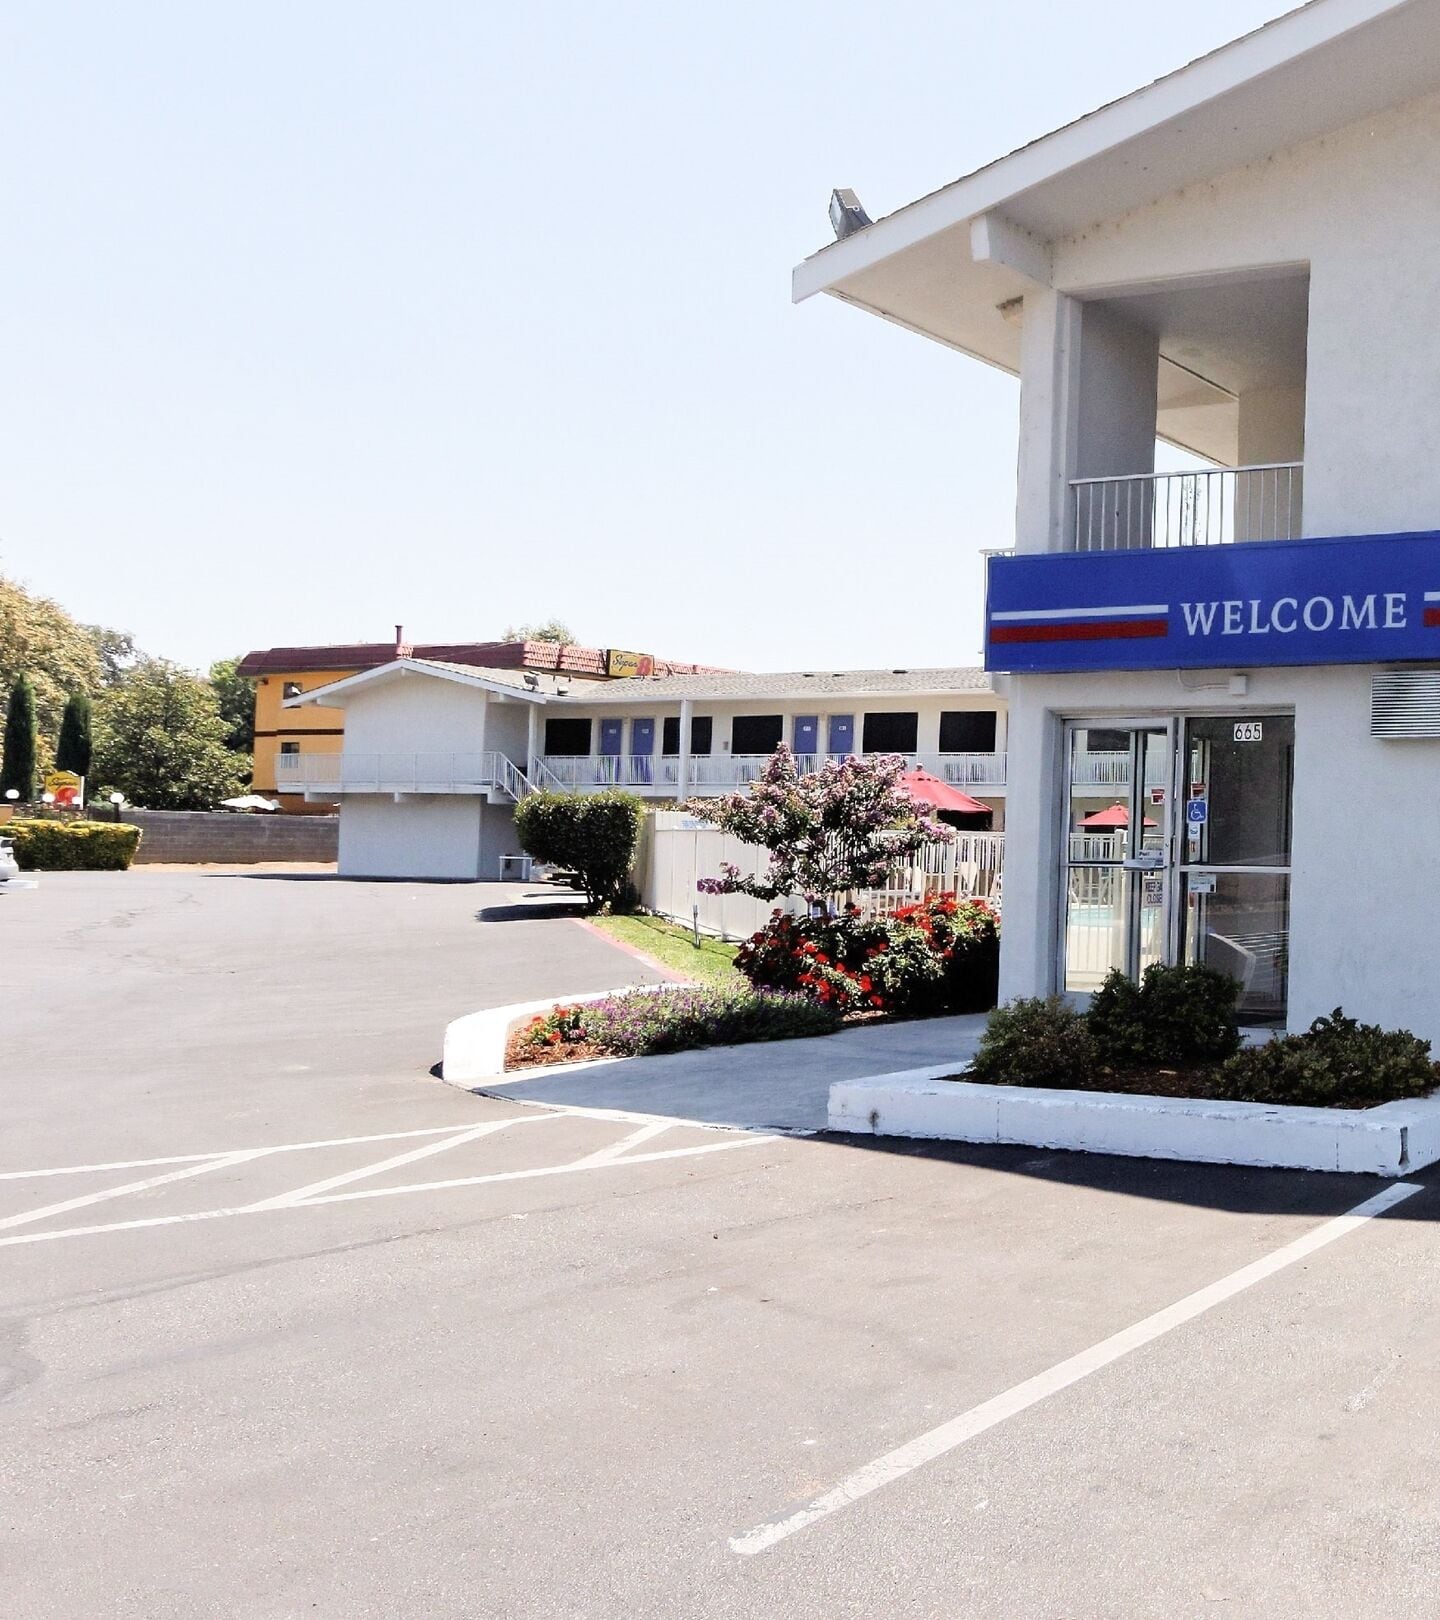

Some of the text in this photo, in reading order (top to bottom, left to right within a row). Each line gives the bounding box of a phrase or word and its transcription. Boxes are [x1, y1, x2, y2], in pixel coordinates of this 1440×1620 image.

[1180, 592, 1407, 636] WELCOME
[612, 654, 638, 671] Super
[1235, 724, 1261, 740] 665
